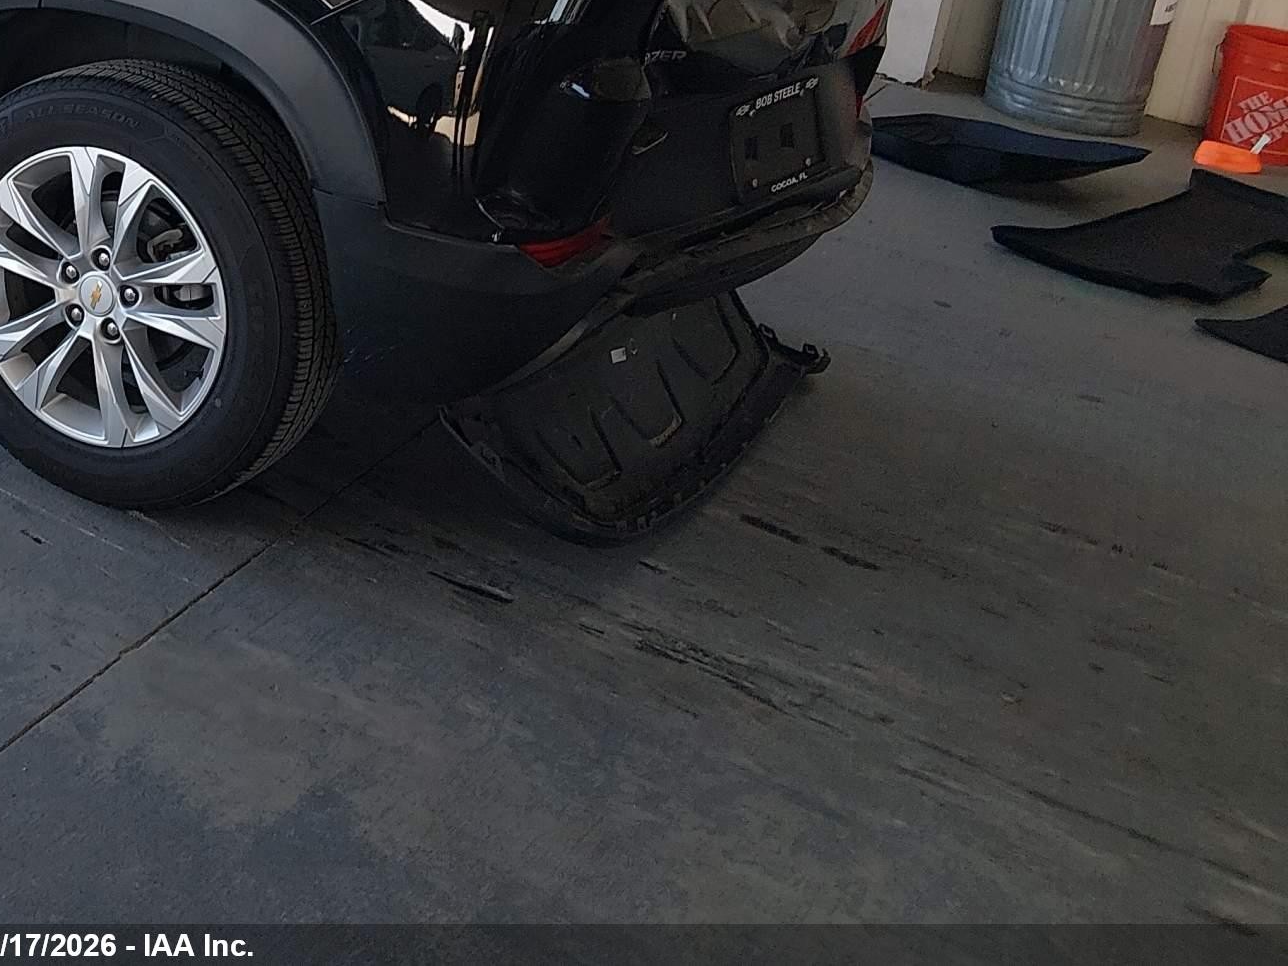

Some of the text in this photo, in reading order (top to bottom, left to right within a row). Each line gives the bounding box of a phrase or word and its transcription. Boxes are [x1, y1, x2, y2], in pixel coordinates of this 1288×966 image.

[755, 81, 801, 110] BOB STEELE
[1238, 90, 1273, 114] THE
[23, 103, 141, 129] ALL SEASON
[1224, 96, 1288, 143] HOM
[798, 171, 808, 181] FL
